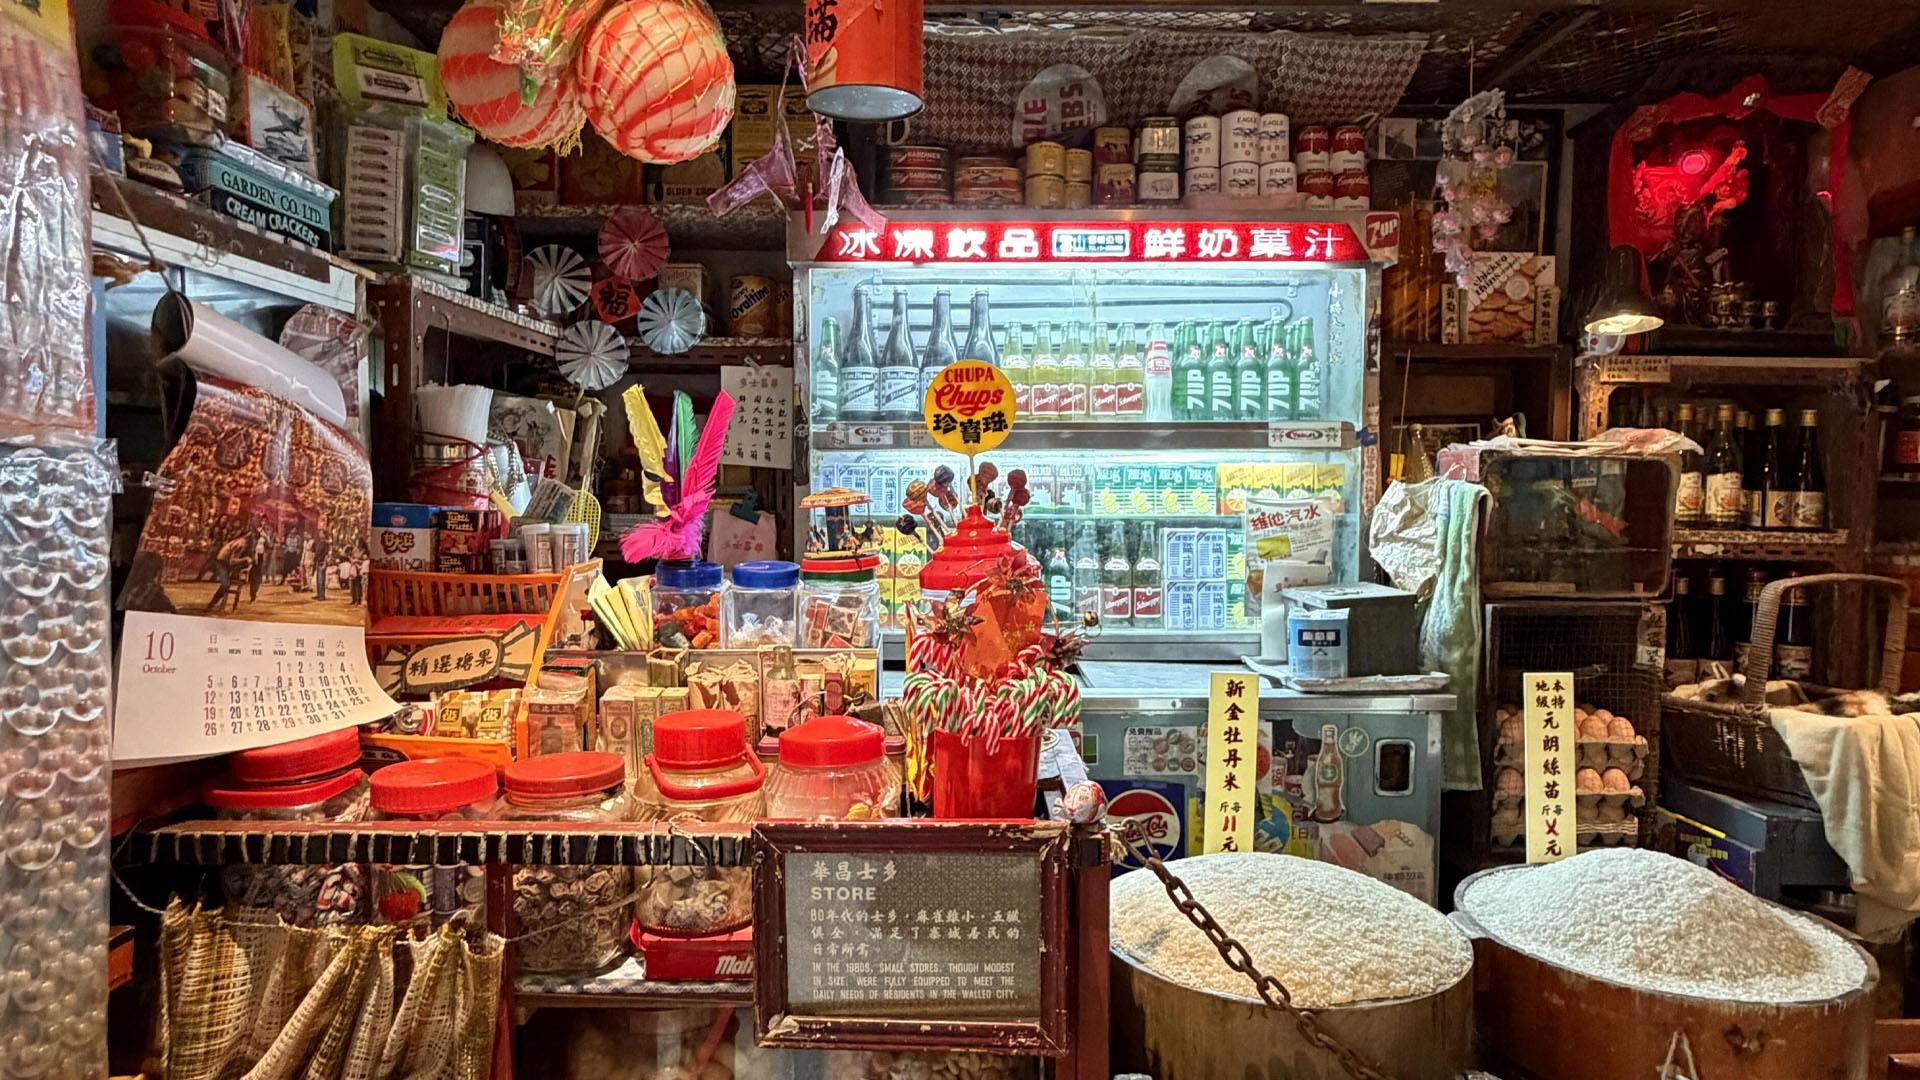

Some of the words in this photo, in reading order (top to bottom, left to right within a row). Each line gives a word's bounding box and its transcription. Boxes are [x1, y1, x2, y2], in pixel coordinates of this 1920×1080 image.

[221, 171, 275, 205] GARDEN
[280, 194, 298, 214] CO.
[302, 206, 324, 225] LTD.
[226, 197, 266, 228] CREAM
[269, 213, 320, 247] CRACKERS
[1143, 227, 1344, 258] 鮮奶菓汁
[601, 282, 631, 318] 福
[944, 367, 995, 382] CHUPA
[933, 384, 1004, 416] Chups
[1187, 370, 1204, 410] 7UP
[1212, 371, 1232, 411] 7UP
[1240, 370, 1261, 411] 7UP
[1267, 370, 1289, 411] 7UP
[933, 410, 1008, 444] 珍寶珠
[1250, 504, 1321, 532] 維他汽水
[1055, 575, 1073, 613] 7UP
[144, 630, 175, 661] 10
[142, 664, 177, 674] October
[276, 661, 281, 673] 1
[298, 661, 303, 674] 2
[318, 661, 325, 674] 3
[340, 662, 346, 673] 4
[408, 648, 494, 677] 精選糖果
[205, 690, 216, 705] 12
[229, 690, 241, 705] 13
[253, 690, 264, 703] 14
[276, 690, 288, 703] 15
[299, 689, 311, 701] 16
[321, 688, 333, 700] 17
[344, 686, 358, 697] 18
[207, 675, 213, 689] 5
[231, 675, 238, 689] 6
[254, 675, 260, 688] 7
[276, 675, 283, 689] 8
[298, 675, 305, 688] 9
[318, 675, 330, 688] 10
[340, 674, 352, 686] 11
[204, 706, 216, 720] 19
[229, 706, 242, 719] 20
[254, 705, 265, 718] 21
[278, 704, 291, 716] 22
[302, 702, 316, 714] 23
[326, 700, 340, 710] 24
[349, 696, 364, 706] 25
[205, 722, 217, 736] 26
[231, 721, 243, 734] 27
[256, 719, 271, 731] 28
[282, 717, 296, 729] 29
[306, 714, 322, 724] 30
[331, 710, 346, 720] 31
[1222, 679, 1246, 792] 新金牡丹米
[1541, 712, 1562, 800] 元朗絲苗
[1221, 836, 1239, 852] 元
[1543, 839, 1562, 856] 元
[810, 859, 898, 882] 華昌士多
[810, 886, 877, 900] STORE
[812, 962, 821, 973] IN
[827, 962, 840, 973] THE
[879, 962, 904, 973] SMALL
[948, 962, 979, 973] THOUGH
[984, 962, 1015, 973] MODEST
[813, 976, 821, 987] IN
[857, 976, 877, 987] WERE
[884, 976, 906, 987] FULLY
[913, 976, 950, 987] EQUIPPED
[957, 976, 967, 987] TO
[974, 976, 993, 987] MEET
[1000, 976, 1015, 987] THE
[813, 990, 835, 1000] DAILY
[840, 990, 864, 1000] NEEDS
[869, 990, 879, 1000] OF
[884, 990, 925, 1000] RESIDENTS
[930, 990, 938, 1000] IN
[943, 990, 956, 1000] THE
[962, 990, 991, 1000] WALLED
[996, 990, 1018, 1000] CITY.
